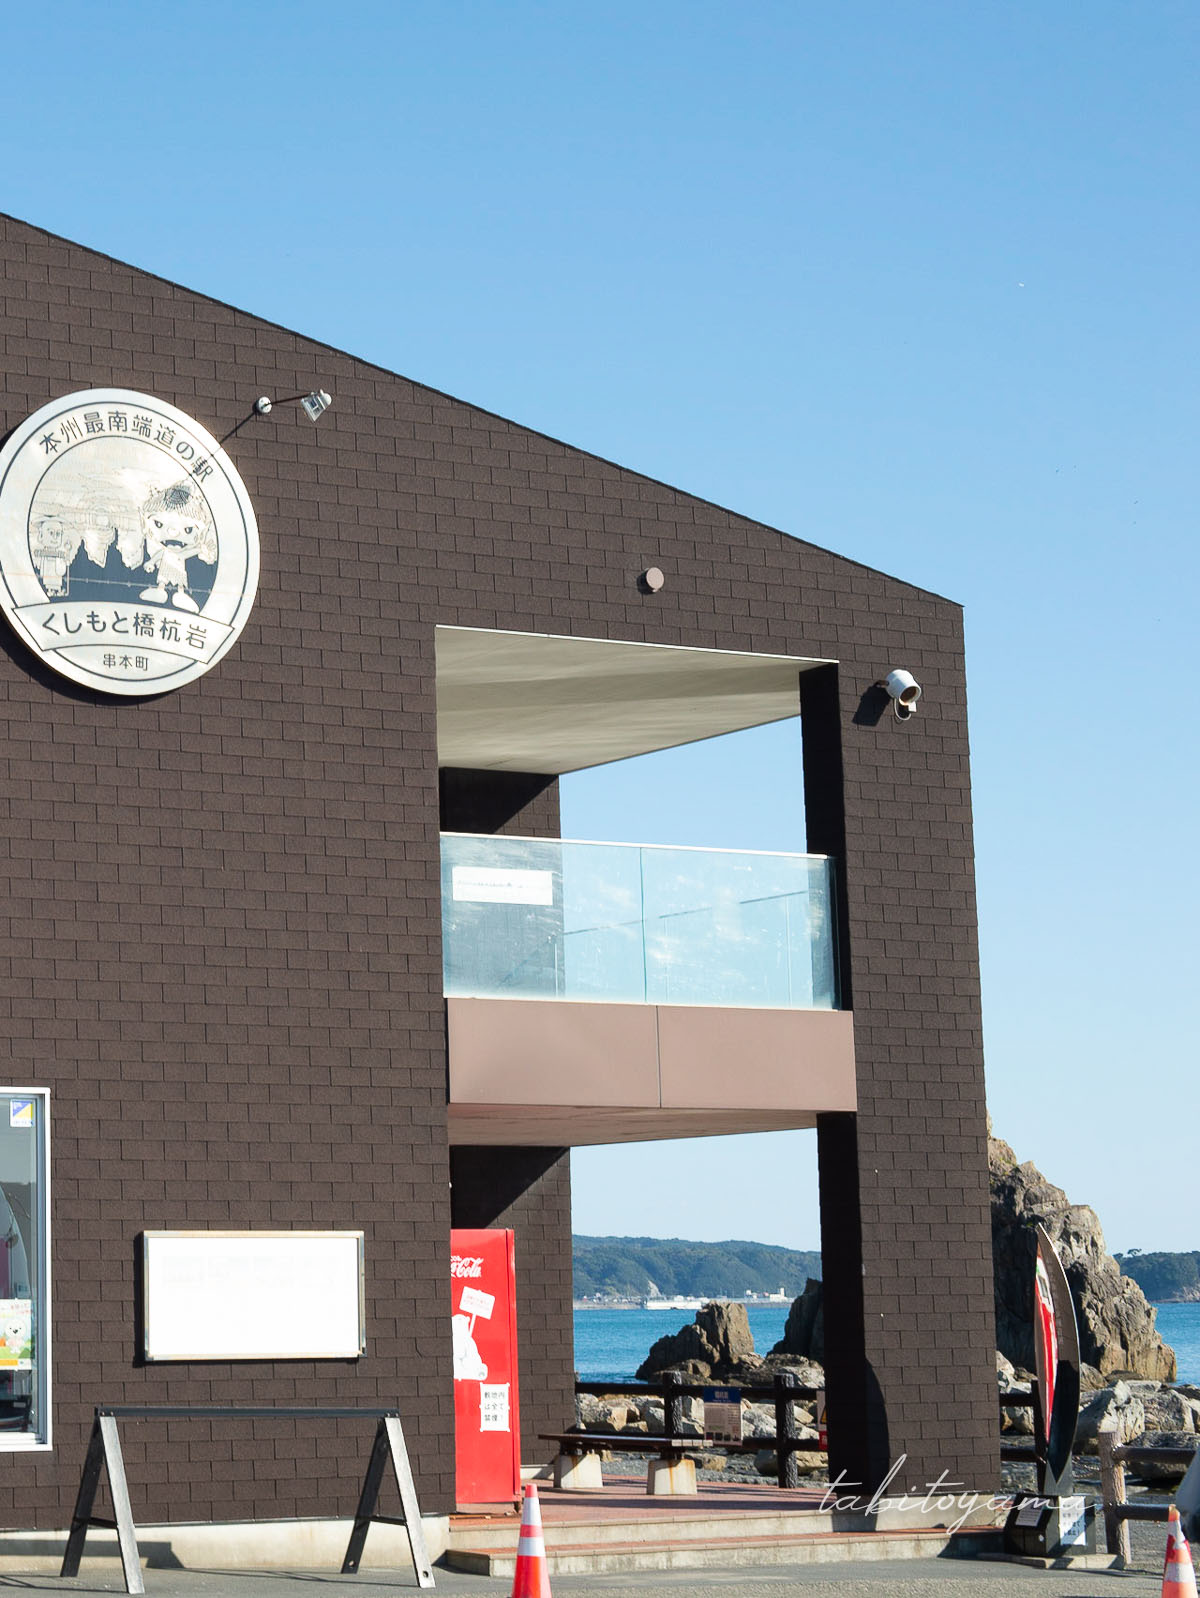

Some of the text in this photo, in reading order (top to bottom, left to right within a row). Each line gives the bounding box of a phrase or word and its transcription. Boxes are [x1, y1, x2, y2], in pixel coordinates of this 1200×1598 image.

[39, 411, 213, 482] 本州最南端道の駅
[42, 611, 207, 649] くしもと橋杭岩
[103, 653, 148, 671] 串本町
